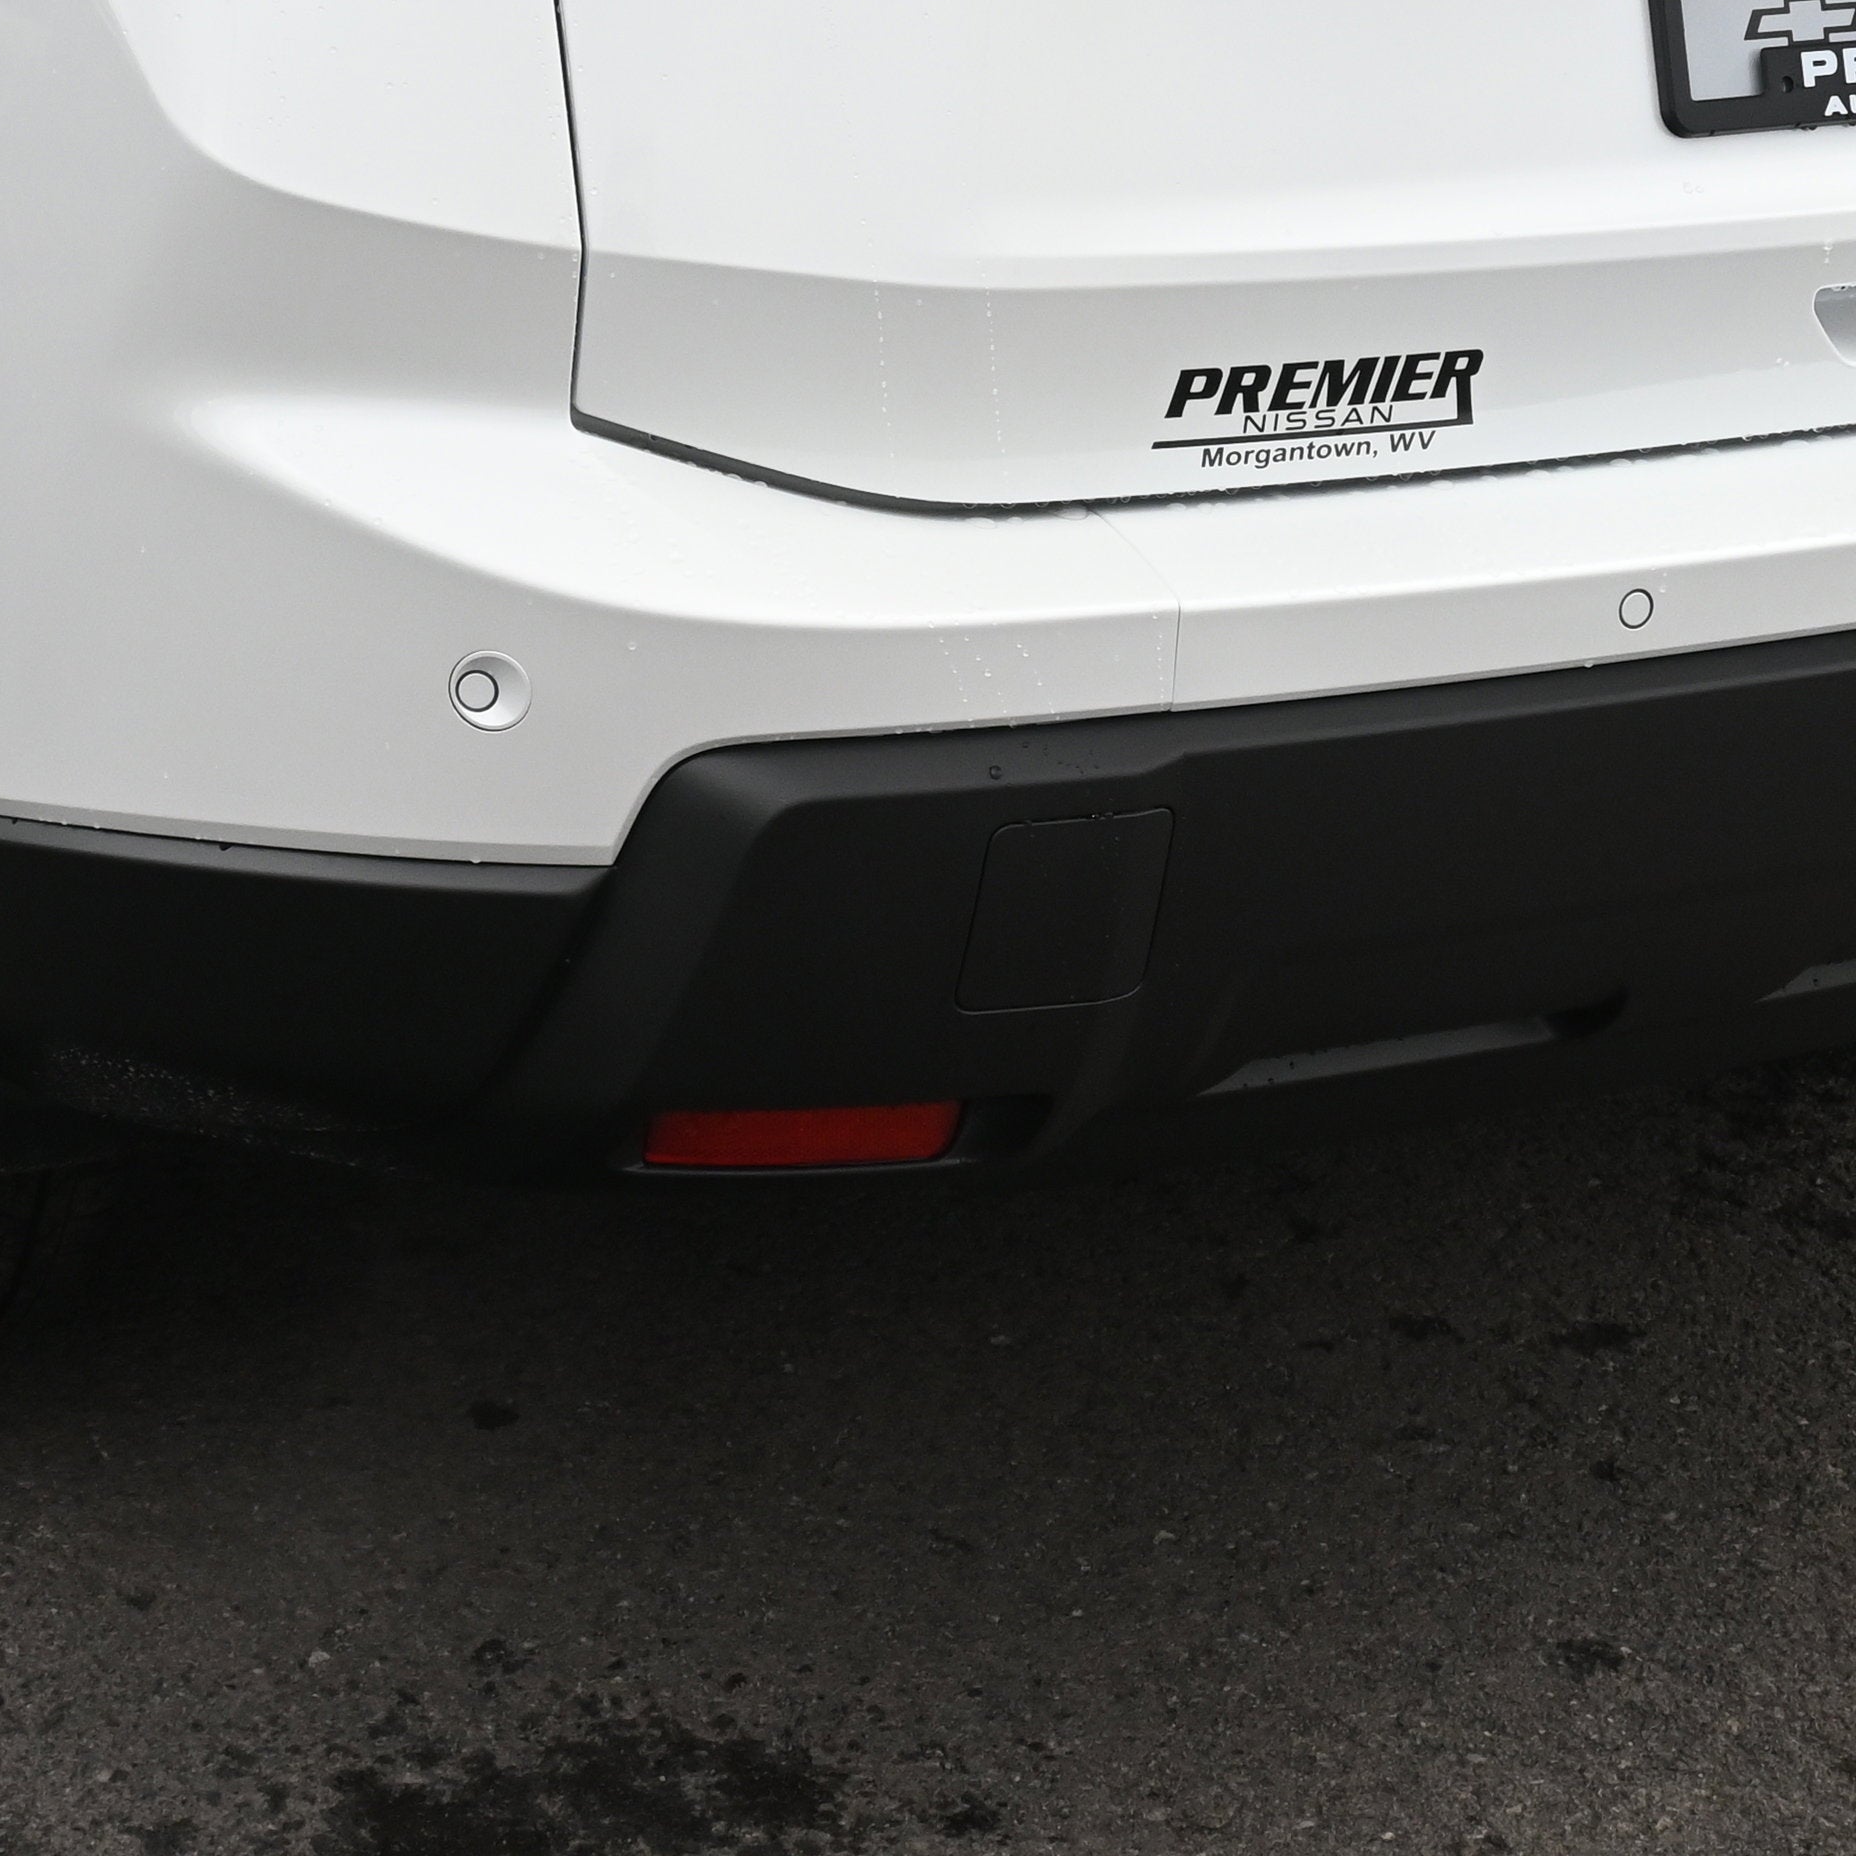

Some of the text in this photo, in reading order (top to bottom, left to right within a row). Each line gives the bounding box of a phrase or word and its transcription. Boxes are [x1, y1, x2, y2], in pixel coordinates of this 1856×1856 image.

[1164, 348, 1484, 422] PREMIER
[1243, 404, 1394, 434] NISSAN
[1200, 430, 1437, 469] Morgantown, WV
